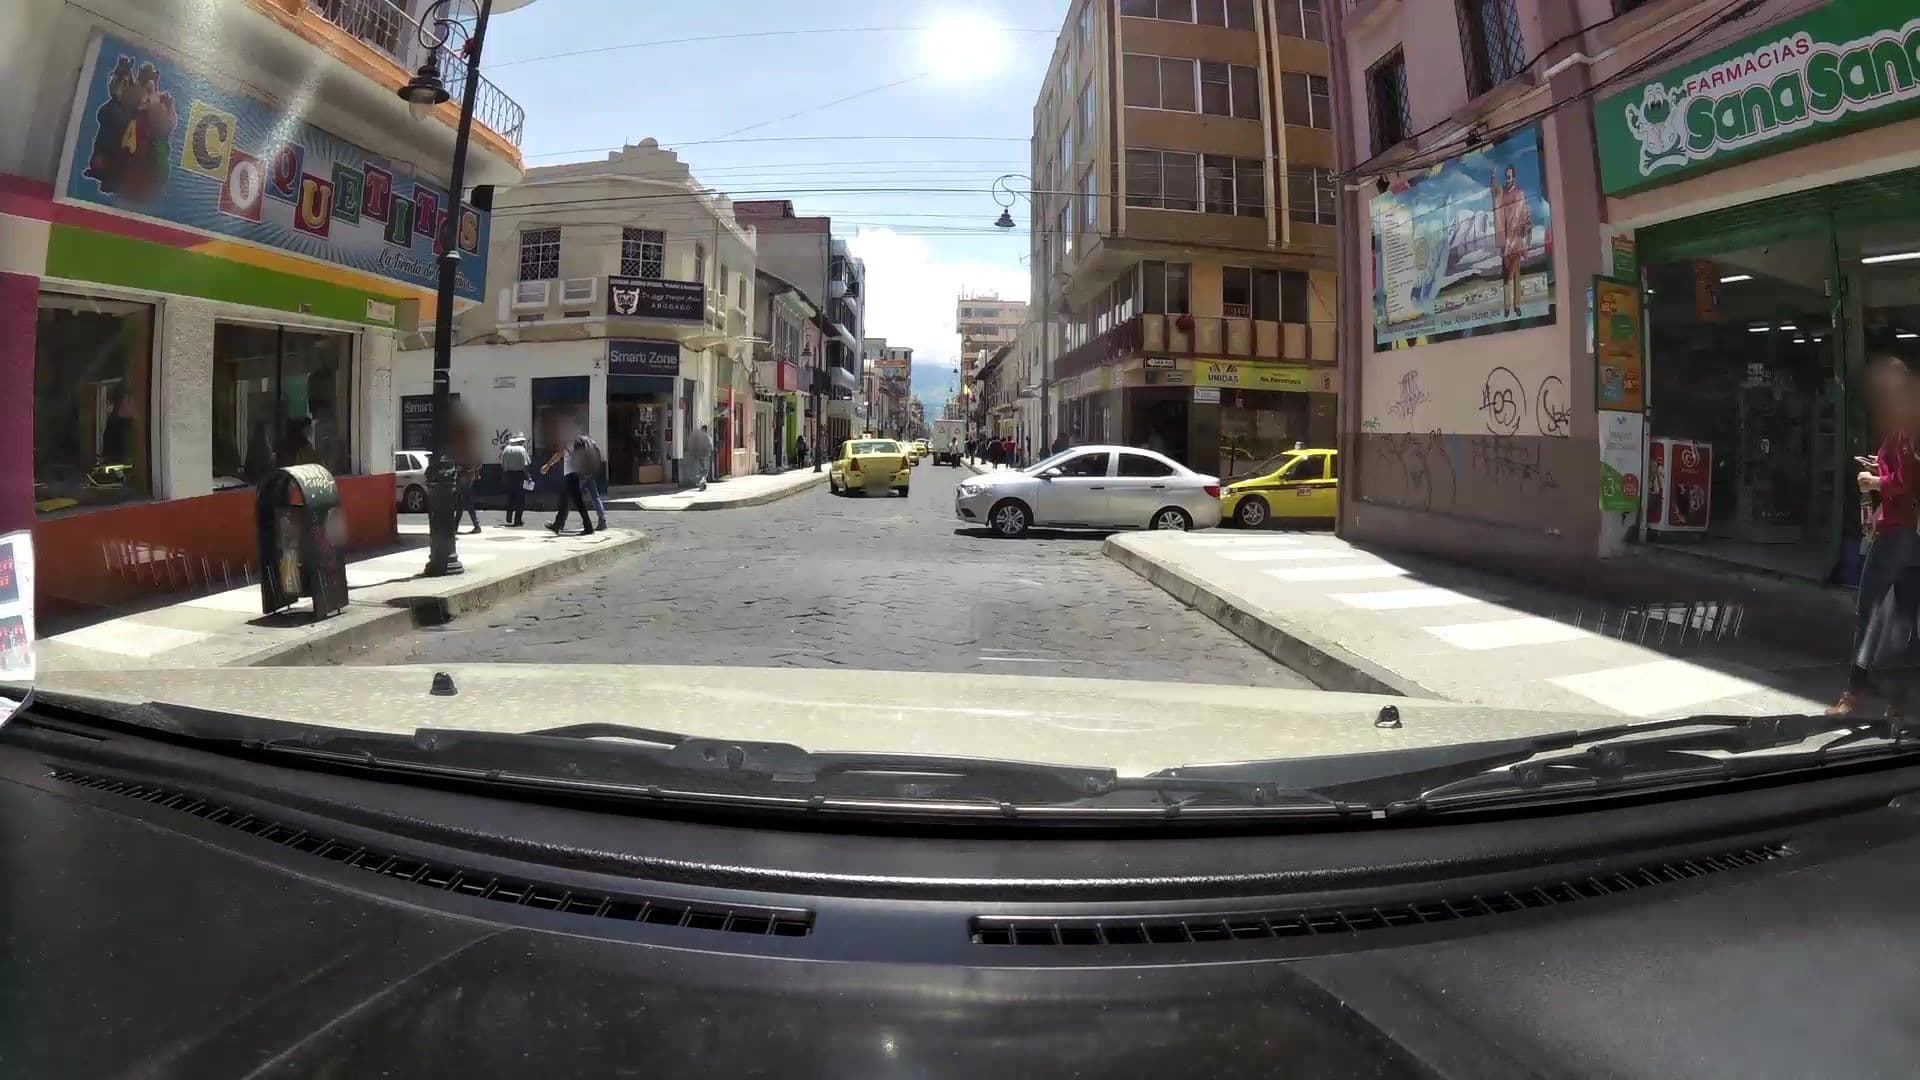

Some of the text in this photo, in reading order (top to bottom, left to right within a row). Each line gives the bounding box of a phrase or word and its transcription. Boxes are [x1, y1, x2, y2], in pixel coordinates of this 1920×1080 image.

[1687, 38, 1810, 97] FARMACIAS
[650, 302, 691, 312] ABOGADO
[611, 350, 677, 365] Smart Zone
[1207, 373, 1239, 384] UNIDAS
